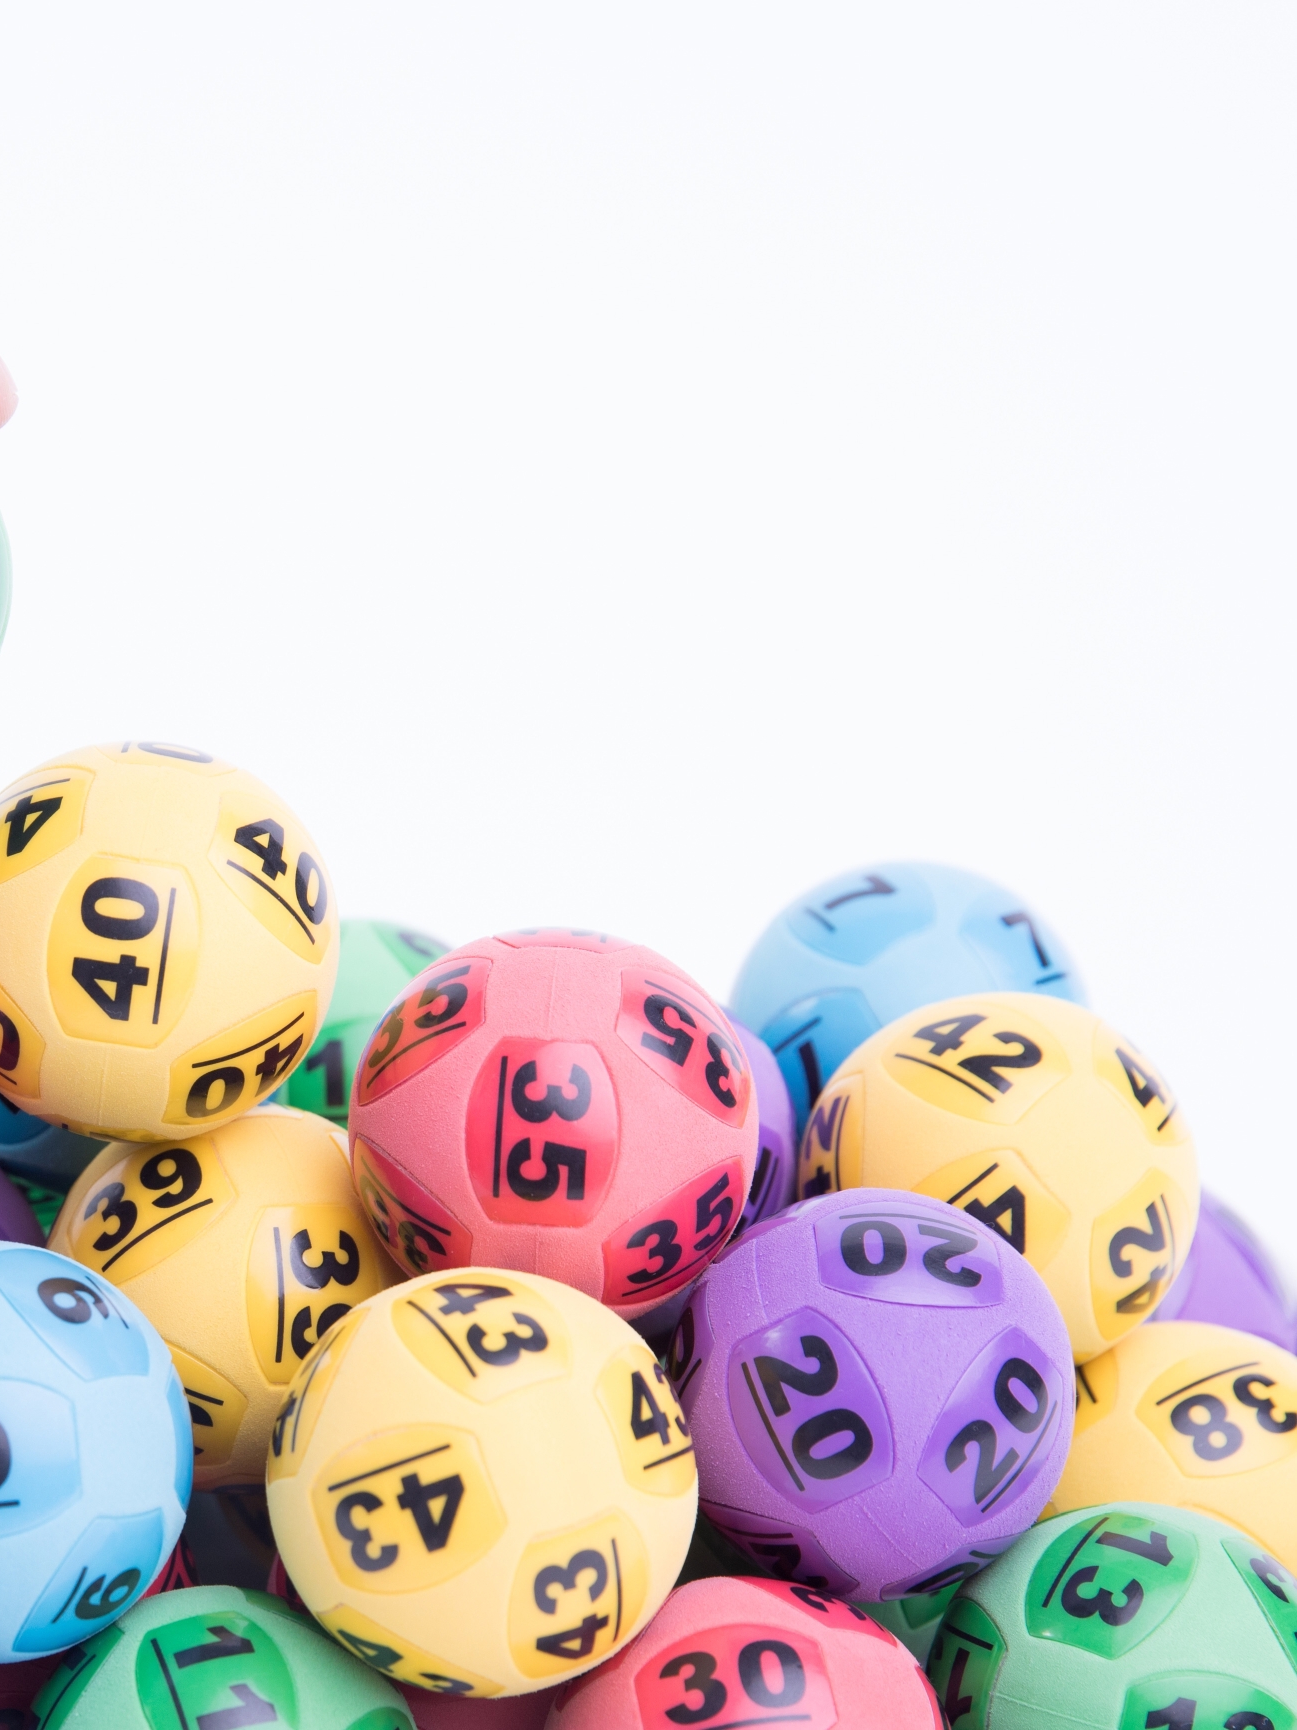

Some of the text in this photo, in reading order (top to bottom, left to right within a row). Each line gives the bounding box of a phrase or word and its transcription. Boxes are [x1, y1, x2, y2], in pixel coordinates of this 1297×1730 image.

[233, 818, 328, 926] 40
[823, 873, 899, 911] 7
[72, 876, 160, 1022] 40
[1000, 911, 1051, 969] 7
[368, 965, 472, 1069] 35
[641, 994, 741, 1109] 35
[912, 1013, 1043, 1095] 42
[184, 1033, 305, 1119] 40
[506, 1060, 592, 1202] 35
[83, 1148, 204, 1252] 39
[626, 1172, 734, 1285] 35
[36, 1277, 111, 1325] 9
[839, 1219, 984, 1289] 20
[1108, 1201, 1171, 1315] 42
[433, 1283, 550, 1367] 43
[753, 1334, 874, 1482] 20
[943, 1356, 1049, 1506] 20
[1169, 1373, 1296, 1463] 38
[334, 1472, 466, 1574] 43
[73, 1567, 142, 1621] 9
[533, 1548, 610, 1660] 43
[1060, 1530, 1175, 1627] 13
[173, 1624, 279, 1730] 11
[658, 1638, 807, 1726] 30
